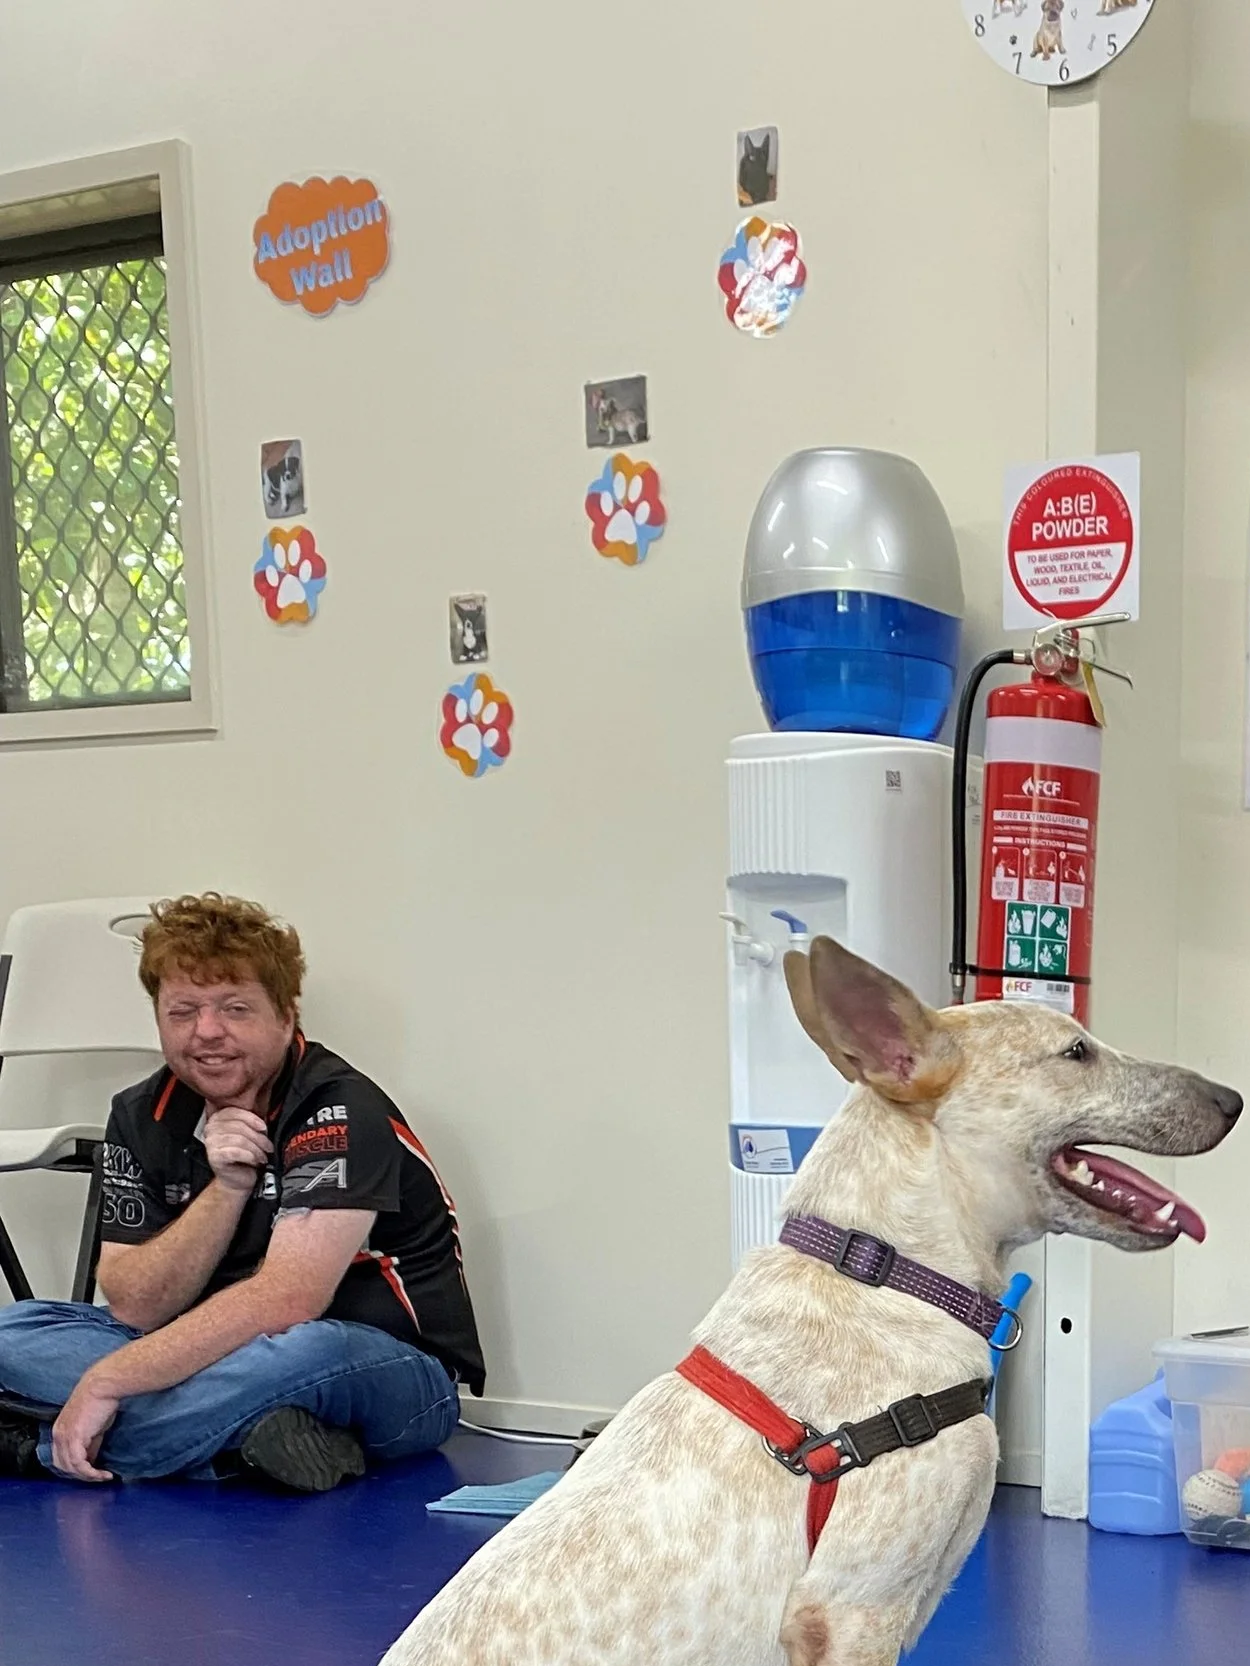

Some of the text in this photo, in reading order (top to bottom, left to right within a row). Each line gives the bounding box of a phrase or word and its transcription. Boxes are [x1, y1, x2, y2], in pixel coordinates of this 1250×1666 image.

[974, 13, 985, 37] 8
[1107, 33, 1117, 57] 5
[1012, 51, 1022, 75] 7
[1059, 58, 1070, 82] 6
[258, 200, 382, 264] Adoption
[290, 248, 353, 295] Wall
[1043, 491, 1097, 518] A:B(E)
[1032, 516, 1109, 541] POWDER
[1027, 548, 1113, 563] TO BE USED FOR PAPER,
[1034, 565, 1058, 574] WOOD,
[1052, 575, 1068, 584] AND
[1069, 572, 1113, 583] ELECTRICAL
[1059, 586, 1080, 595] FIRES
[1035, 780, 1061, 797] FCF
[1001, 811, 1081, 826] FIRE EXTINGUISHER
[1014, 837, 1066, 849] INSTRUCTIONS
[1014, 981, 1032, 992] FCF
